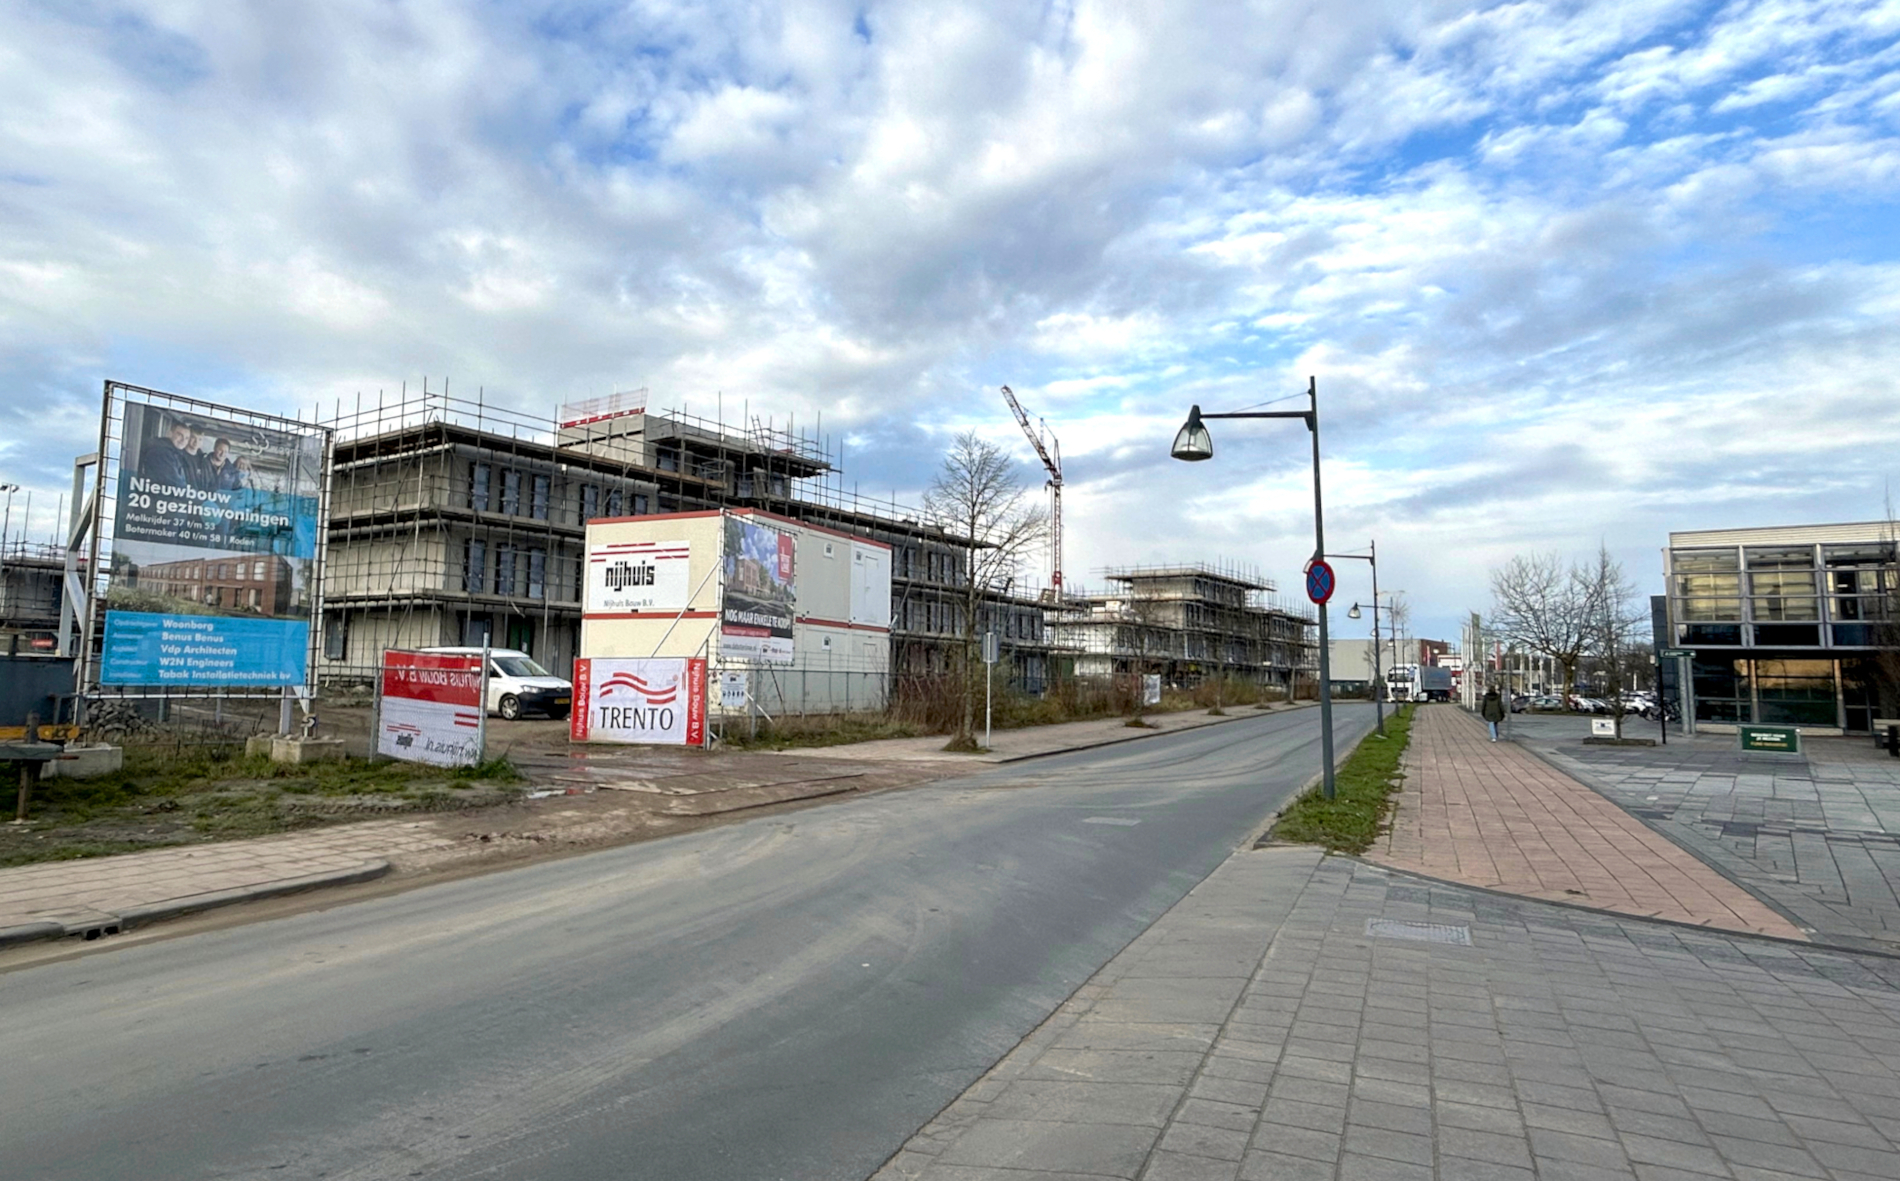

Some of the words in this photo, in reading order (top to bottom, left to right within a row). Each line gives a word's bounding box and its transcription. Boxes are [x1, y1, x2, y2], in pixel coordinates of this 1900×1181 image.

[129, 476, 232, 504] Nieuwbouw
[127, 493, 151, 509] 20
[155, 498, 290, 527] gezinswoningen
[125, 513, 171, 526] Melkrijder
[173, 517, 185, 527] 37
[186, 519, 203, 530] t/m
[204, 521, 216, 531] 53
[125, 524, 177, 539] Botermaker
[178, 530, 191, 540] 40
[192, 531, 208, 541] t/m
[209, 533, 221, 543] 58
[229, 535, 255, 547] Roden
[605, 560, 655, 592] nijhuis
[603, 599, 624, 610] Nijhuis
[625, 599, 642, 607] Bouw
[642, 599, 655, 607] B.V.
[162, 619, 214, 632] Woonborg
[724, 609, 738, 622] NOG
[738, 610, 754, 625] MAAR
[754, 613, 772, 627] ENKELE
[161, 631, 193, 641] Benus
[194, 633, 224, 643] Benus
[160, 644, 181, 655] Vdp
[183, 645, 238, 656] Architecten
[159, 657, 185, 667] W2N
[187, 658, 234, 668] Engineers
[158, 669, 189, 679] Tabak
[191, 670, 277, 680] Installatietechniek
[279, 672, 291, 680] bv
[691, 662, 702, 693] Nijhuis
[577, 682, 587, 707] Bouw
[600, 706, 674, 731] TRENTO
[692, 694, 701, 720] Bouw
[575, 708, 585, 737] Nijhuis
